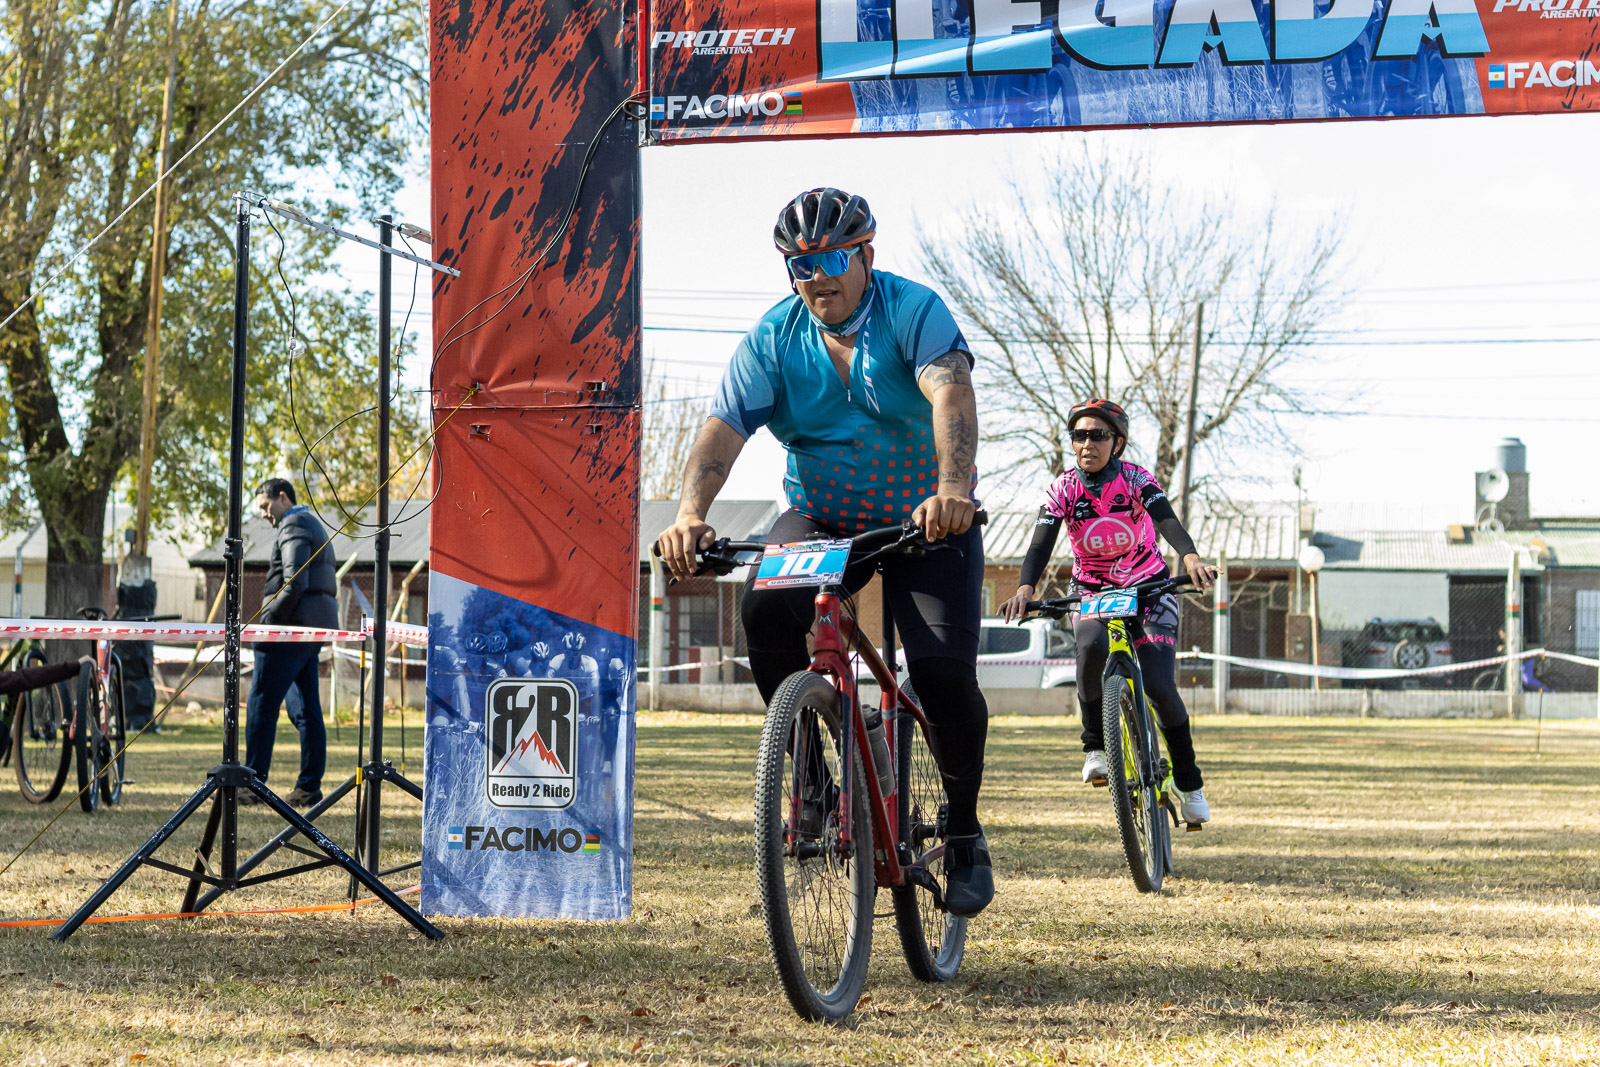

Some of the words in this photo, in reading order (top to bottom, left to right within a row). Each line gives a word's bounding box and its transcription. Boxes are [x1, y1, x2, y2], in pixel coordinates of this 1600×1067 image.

[650, 28, 797, 49] PROTECH
[691, 46, 754, 56] ARGENTINA
[667, 91, 785, 120] FACIMO
[777, 551, 827, 577] 10
[1087, 596, 1133, 613] 173
[492, 783, 530, 799] Ready
[532, 784, 540, 798] 2
[543, 784, 571, 798] Ride
[465, 826, 583, 853] FACIMO
